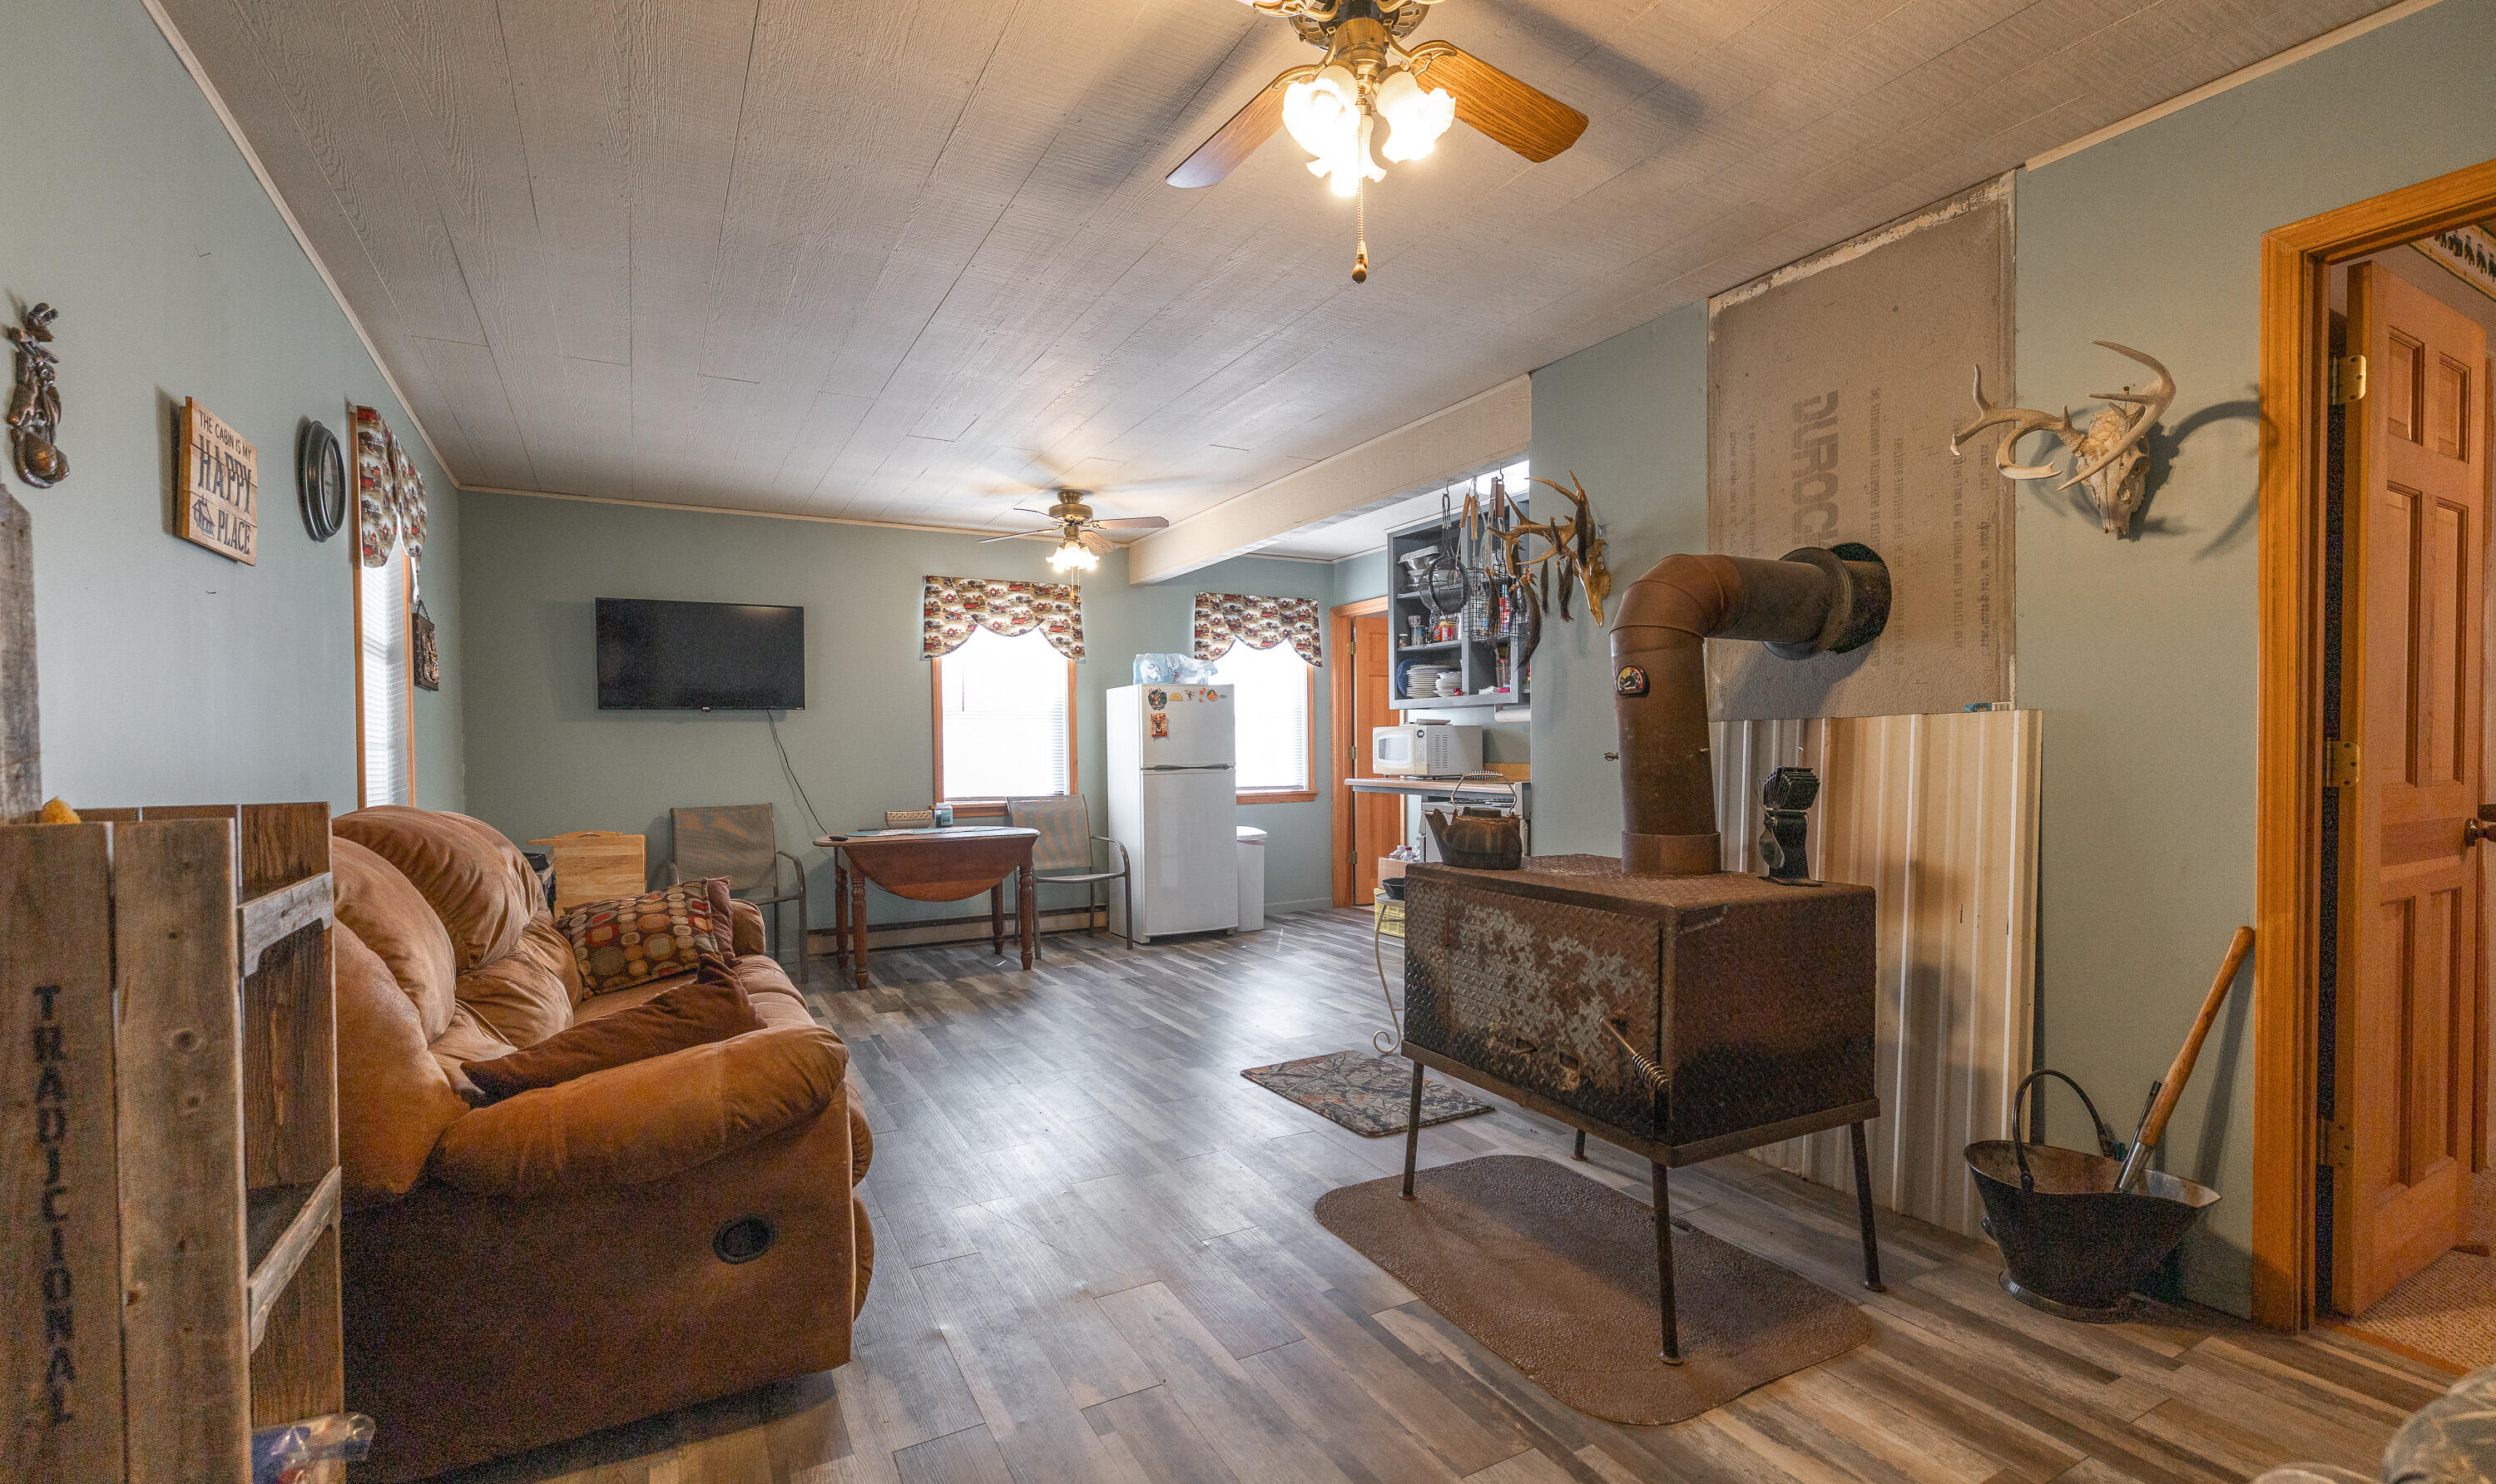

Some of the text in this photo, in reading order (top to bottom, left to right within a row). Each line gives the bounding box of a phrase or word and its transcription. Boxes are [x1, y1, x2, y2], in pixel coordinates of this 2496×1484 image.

[199, 408, 251, 462] THE CABIN IS MY
[198, 433, 251, 514] HAPPY
[216, 508, 251, 556] PLACE
[32, 985, 74, 1425] TRADICIONAL
